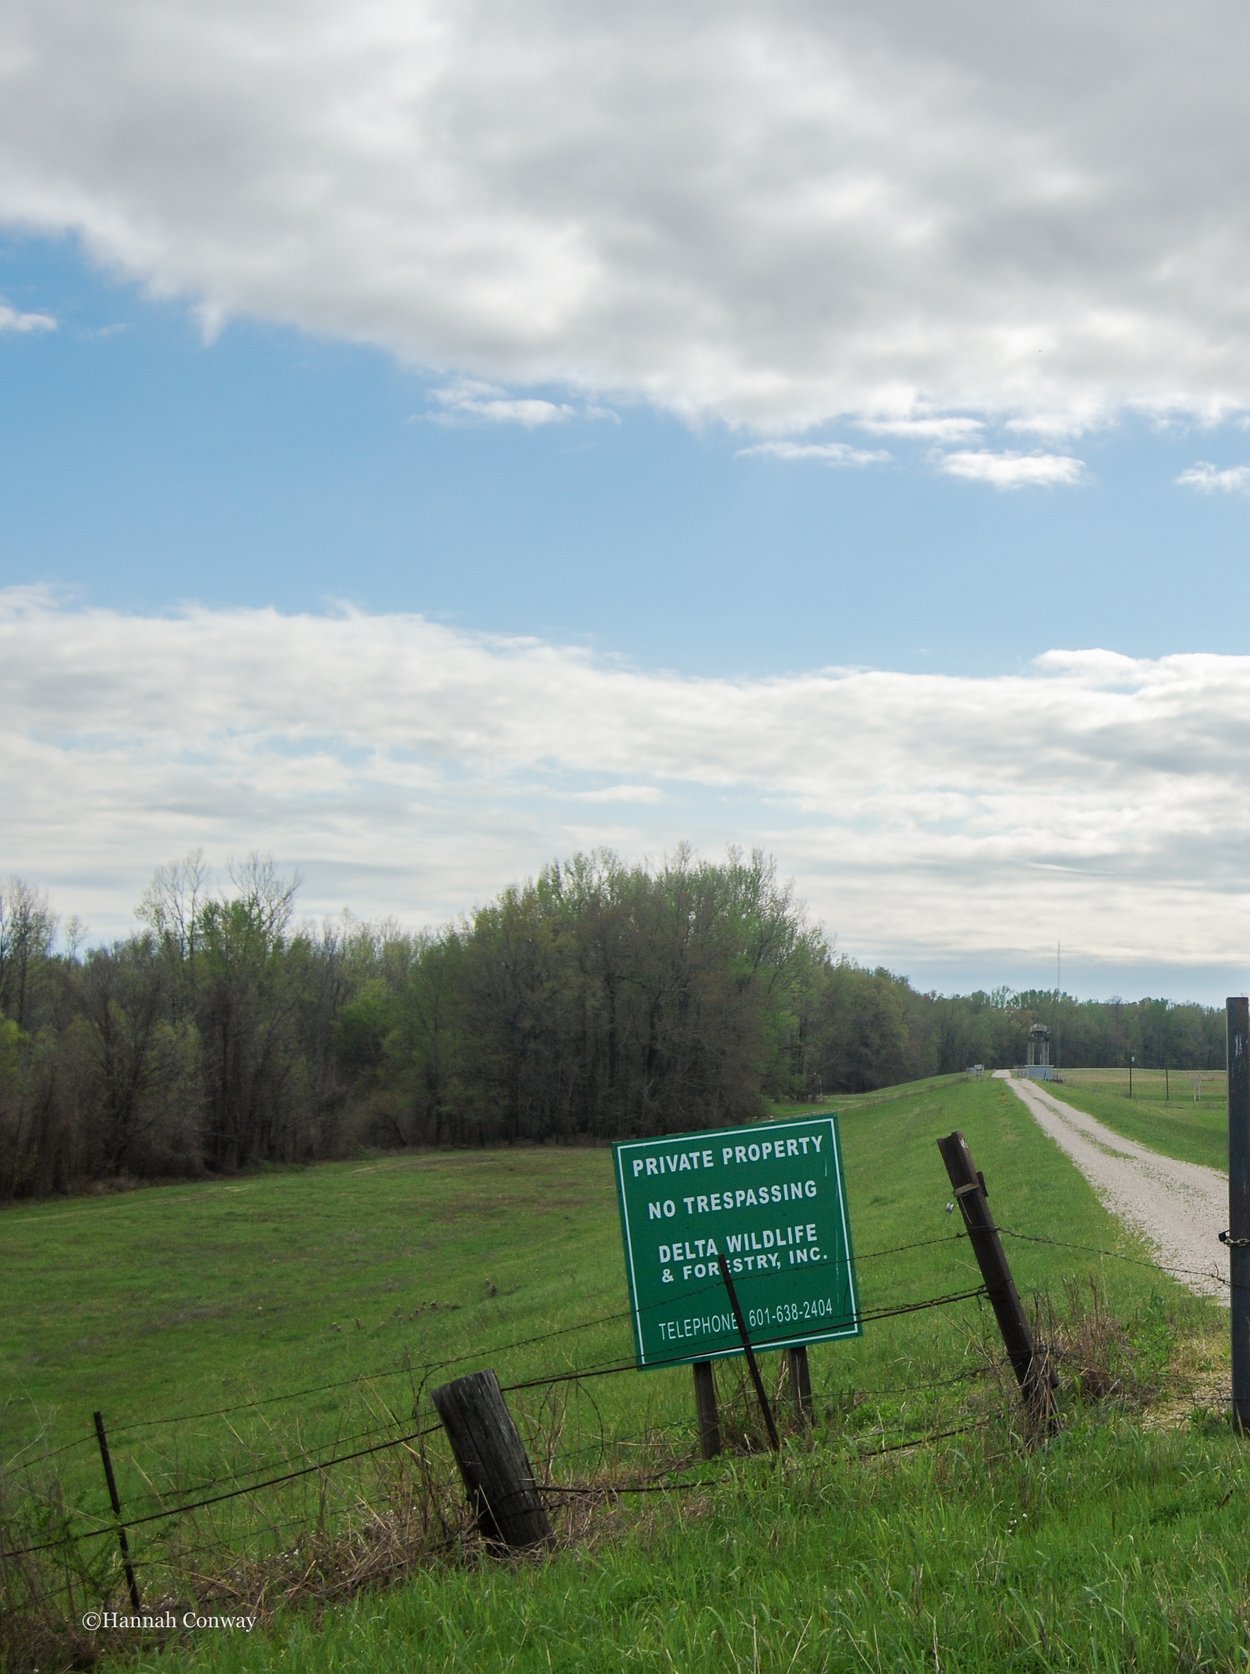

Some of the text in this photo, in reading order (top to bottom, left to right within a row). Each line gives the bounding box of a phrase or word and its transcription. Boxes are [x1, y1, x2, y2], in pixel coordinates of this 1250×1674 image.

[632, 1135, 823, 1177] PRIVATE PROPERTY
[648, 1180, 817, 1220] NO TRESPASSING
[658, 1223, 818, 1263] DELTA WILDLIFE
[661, 1268, 674, 1283] &
[789, 1247, 828, 1264] INC.
[659, 1298, 833, 1341] TELEPHONE 601-638-2404
